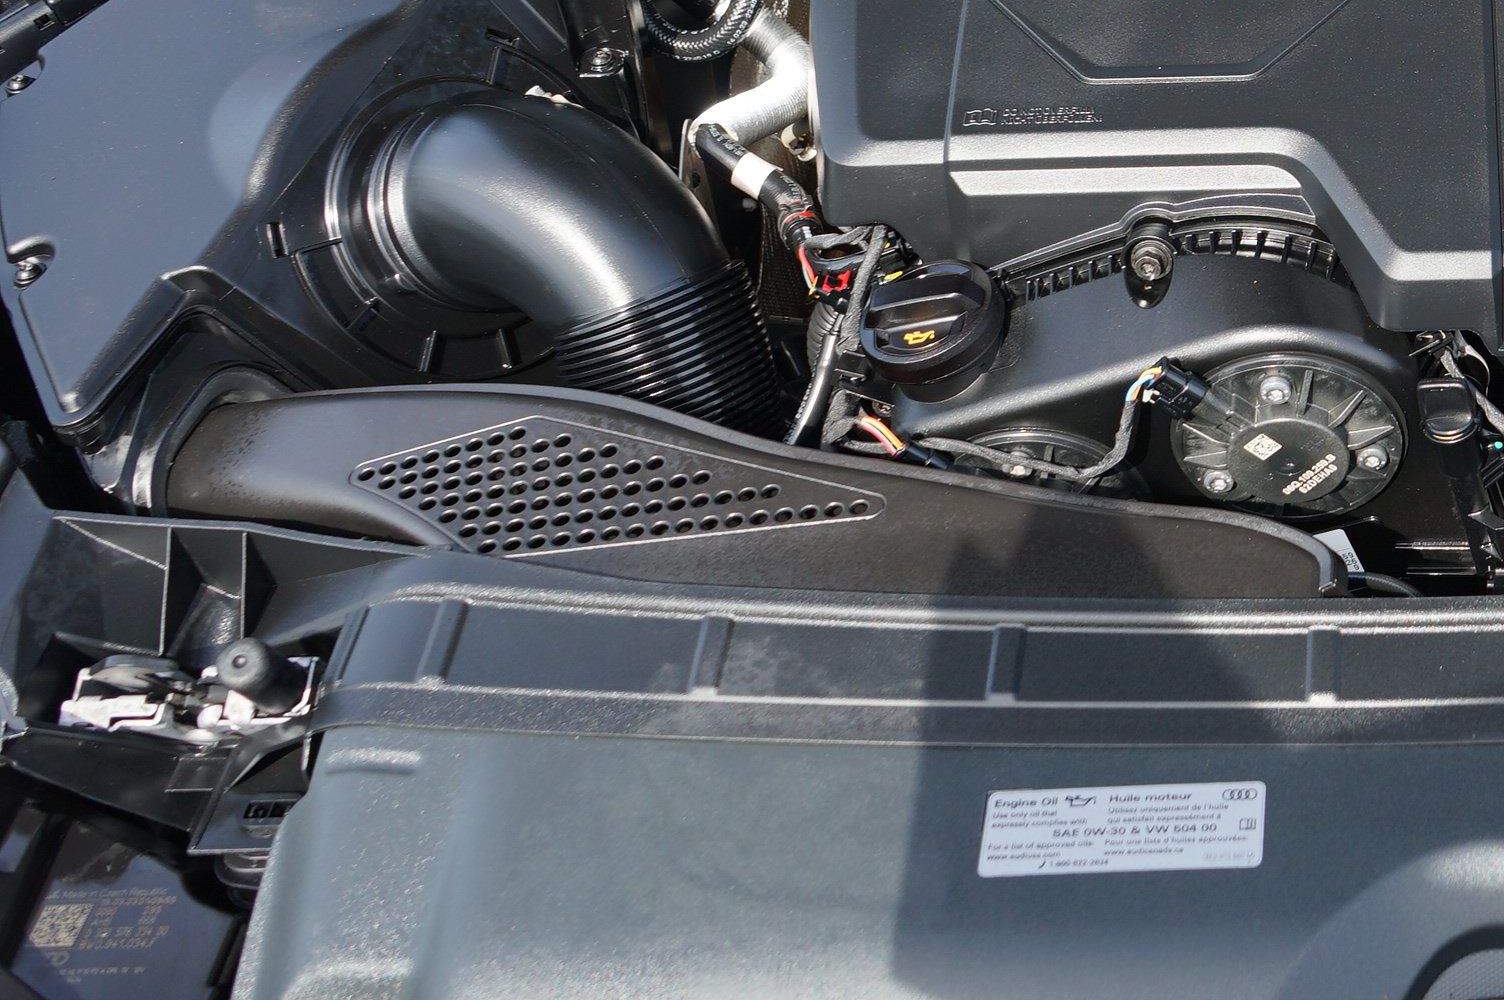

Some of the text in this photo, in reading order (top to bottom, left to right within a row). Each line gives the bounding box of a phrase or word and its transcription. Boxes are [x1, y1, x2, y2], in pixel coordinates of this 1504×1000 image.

[994, 796, 1058, 809] Engine Oil
[1109, 792, 1192, 803] Huile moteur
[1052, 823, 1217, 838] SAE 0W-30 & VW 504 00
